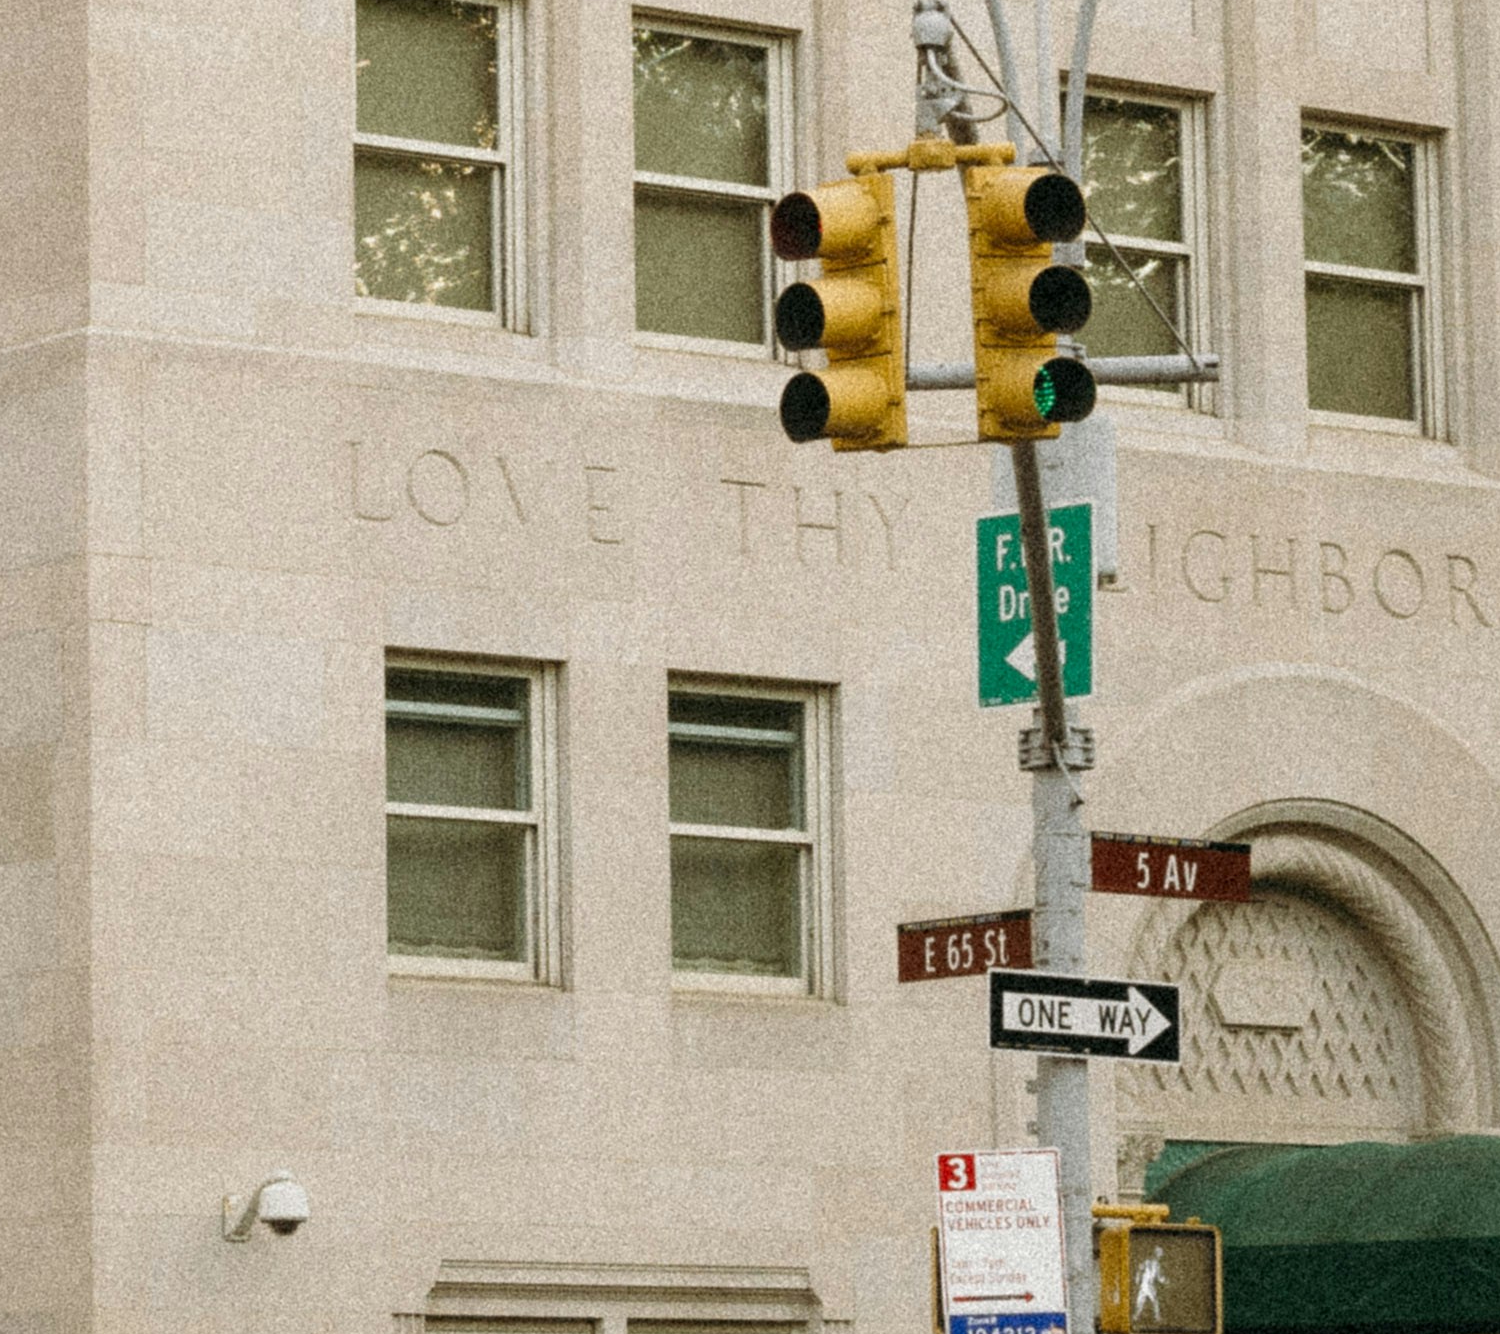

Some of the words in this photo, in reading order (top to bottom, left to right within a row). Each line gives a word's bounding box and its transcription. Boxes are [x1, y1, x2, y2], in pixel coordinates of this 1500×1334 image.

[348, 441, 621, 545] LOVE
[719, 479, 908, 569] THY
[1102, 524, 1493, 628] IGHBOR
[999, 585, 1070, 622] Dre
[1137, 852, 1150, 889] 5
[1163, 854, 1197, 893] Av
[924, 937, 936, 973] E
[947, 933, 973, 971] 65
[984, 928, 1010, 967] St
[1018, 998, 1072, 1030] ONE
[1098, 1004, 1152, 1036] WAY
[948, 1157, 968, 1189] 3
[946, 1198, 1038, 1214] COMMERCIAL
[949, 1217, 1012, 1232] VEHICLES
[1016, 1216, 1050, 1229] ONLY
